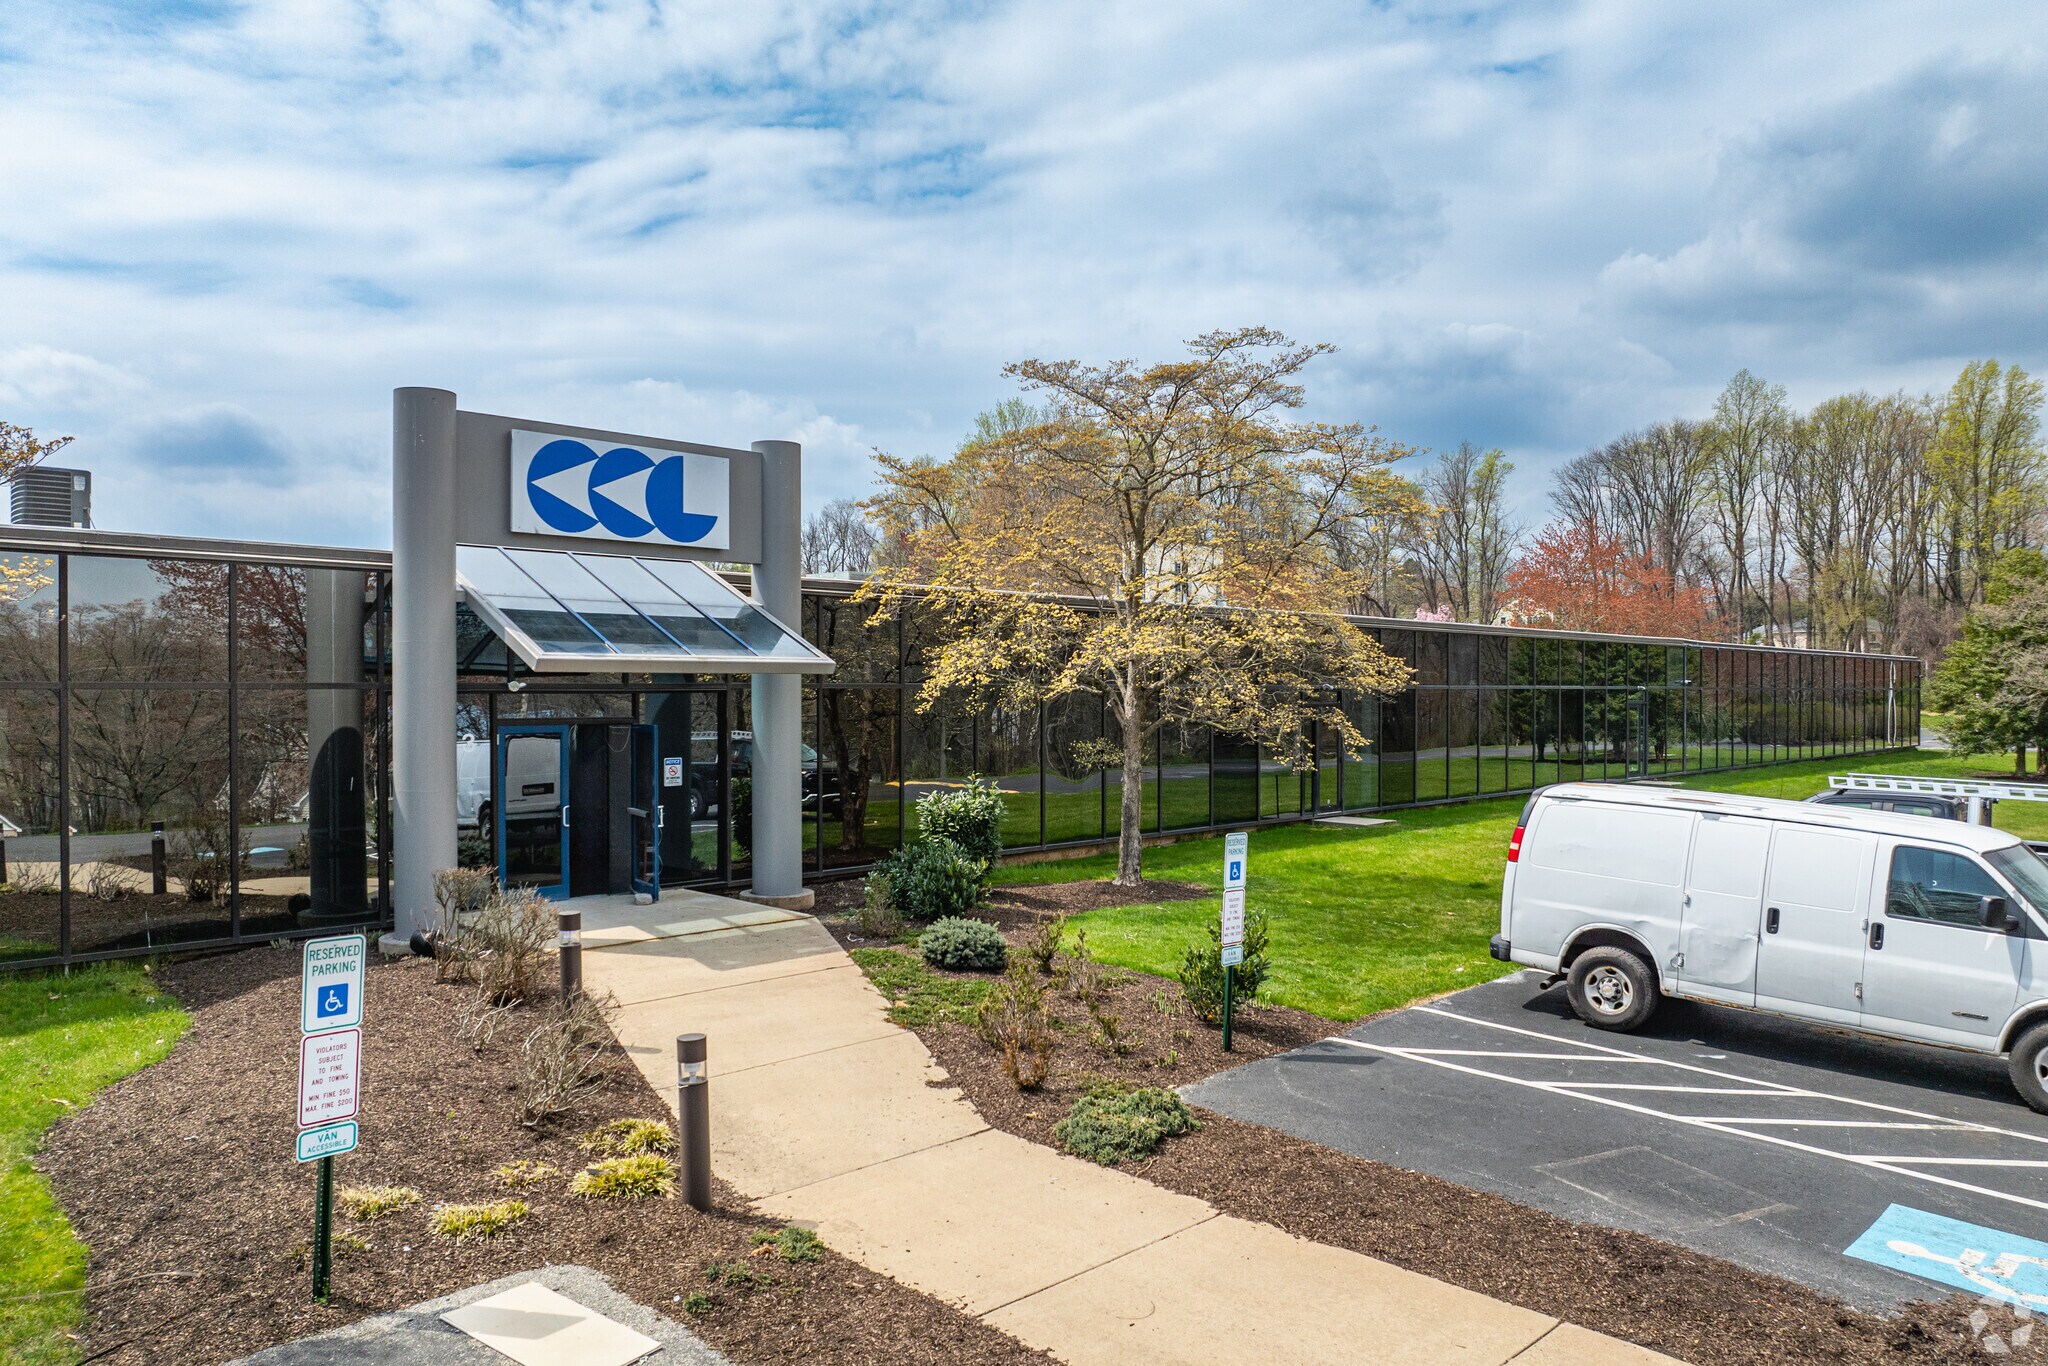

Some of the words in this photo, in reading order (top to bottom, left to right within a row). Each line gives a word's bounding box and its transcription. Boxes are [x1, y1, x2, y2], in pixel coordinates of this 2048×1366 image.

[527, 439, 718, 543] CCL
[1227, 838, 1245, 846] RESERVED
[309, 945, 360, 961] RESERVED
[313, 961, 356, 976] PARKING
[316, 1043, 347, 1054] VIOLATORS
[318, 1054, 344, 1064] SUBJECT
[330, 1065, 342, 1073] FINE
[329, 1074, 349, 1082] TOWING
[323, 1091, 336, 1099] FINE
[339, 1088, 350, 1096] $50
[321, 1101, 334, 1110] FINE
[318, 1132, 337, 1142] VAN
[307, 1140, 347, 1153] ACCESSIBLE
